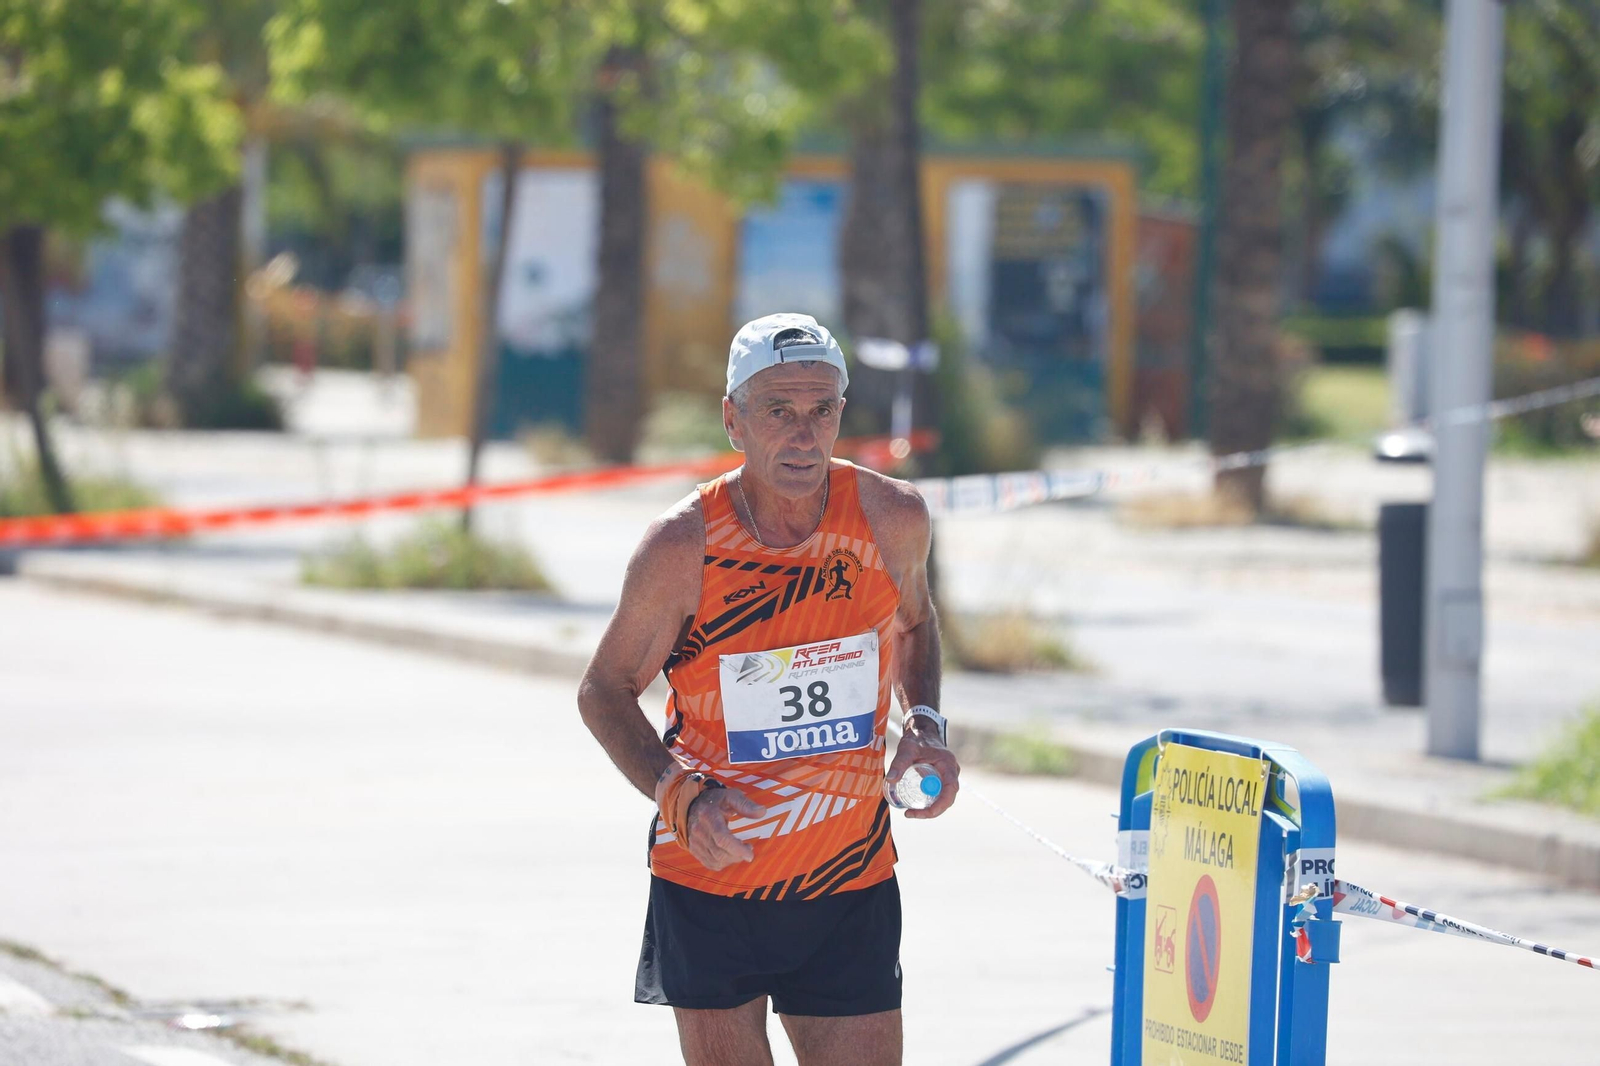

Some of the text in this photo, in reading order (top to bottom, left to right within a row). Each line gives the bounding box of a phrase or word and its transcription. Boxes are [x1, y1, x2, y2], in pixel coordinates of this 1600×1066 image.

[831, 548, 843, 556] DEL
[844, 548, 864, 573] DEPORTE
[791, 650, 863, 670] ATLETISMO
[795, 642, 841, 660] RFEA
[787, 659, 866, 680] RUTA RUNNING
[778, 680, 832, 723] 38
[1172, 765, 1258, 817] POLICÍA LOCAL
[1184, 820, 1234, 870] MÁLAGA
[1145, 1018, 1244, 1065] PROHIBIDO ESTACIONAR DESDE
